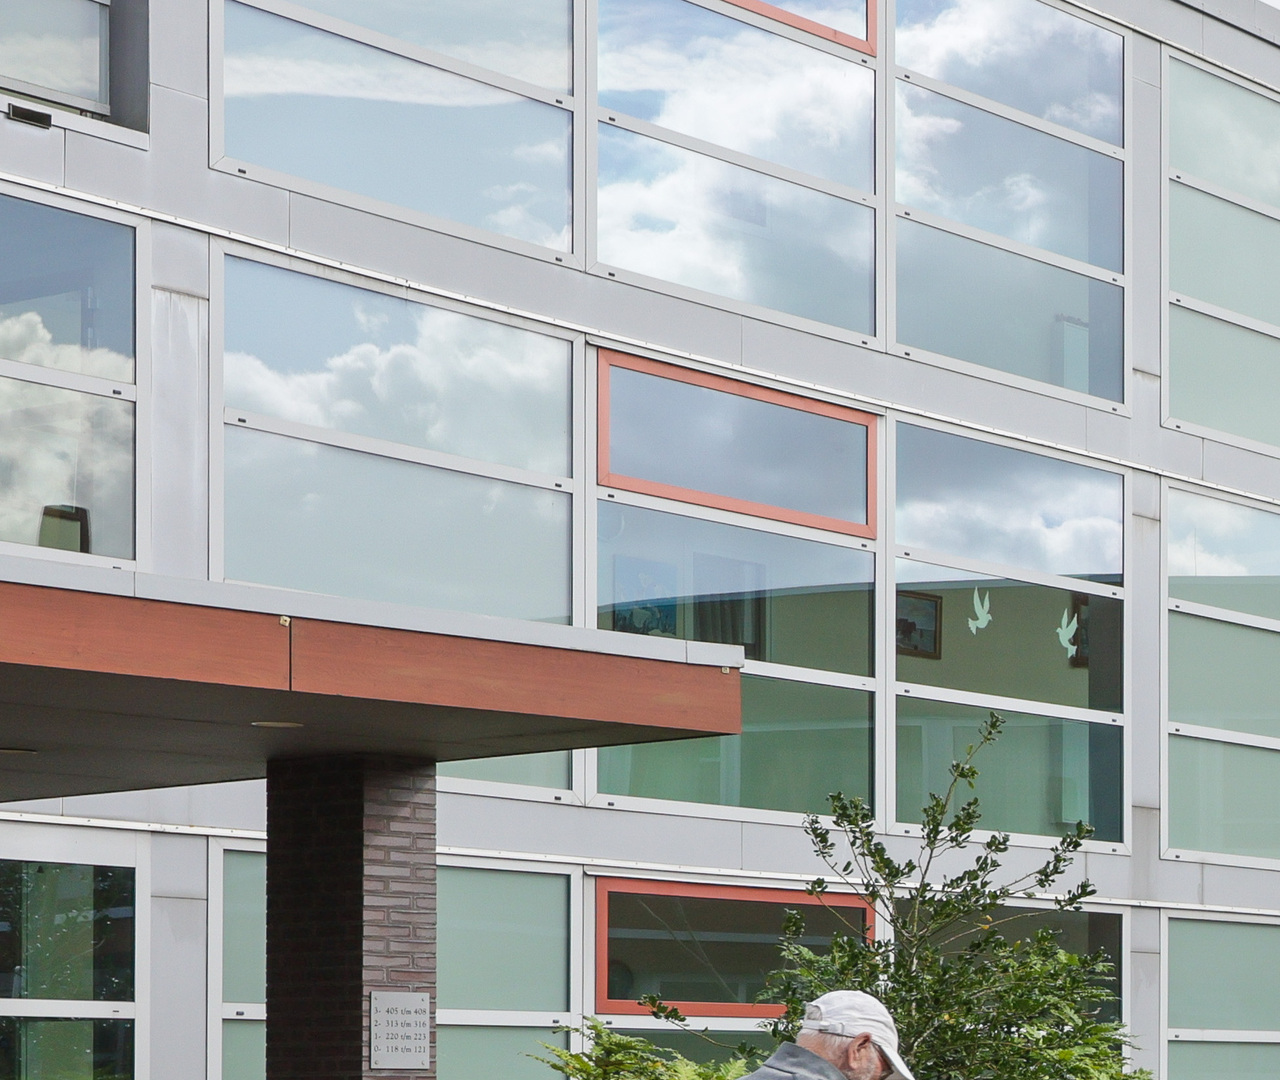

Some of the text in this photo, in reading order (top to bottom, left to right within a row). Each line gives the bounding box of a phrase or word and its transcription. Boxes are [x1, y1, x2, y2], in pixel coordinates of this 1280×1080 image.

[385, 1007, 399, 1015] 405
[400, 1007, 412, 1015] t/m
[413, 1007, 427, 1015] 408
[385, 1020, 399, 1028] 313
[400, 1020, 412, 1028] t/m
[413, 1020, 427, 1028] 316
[413, 1033, 427, 1041] 223
[386, 1045, 399, 1053] 118
[400, 1045, 412, 1053] t/m
[414, 1045, 426, 1053] 121
